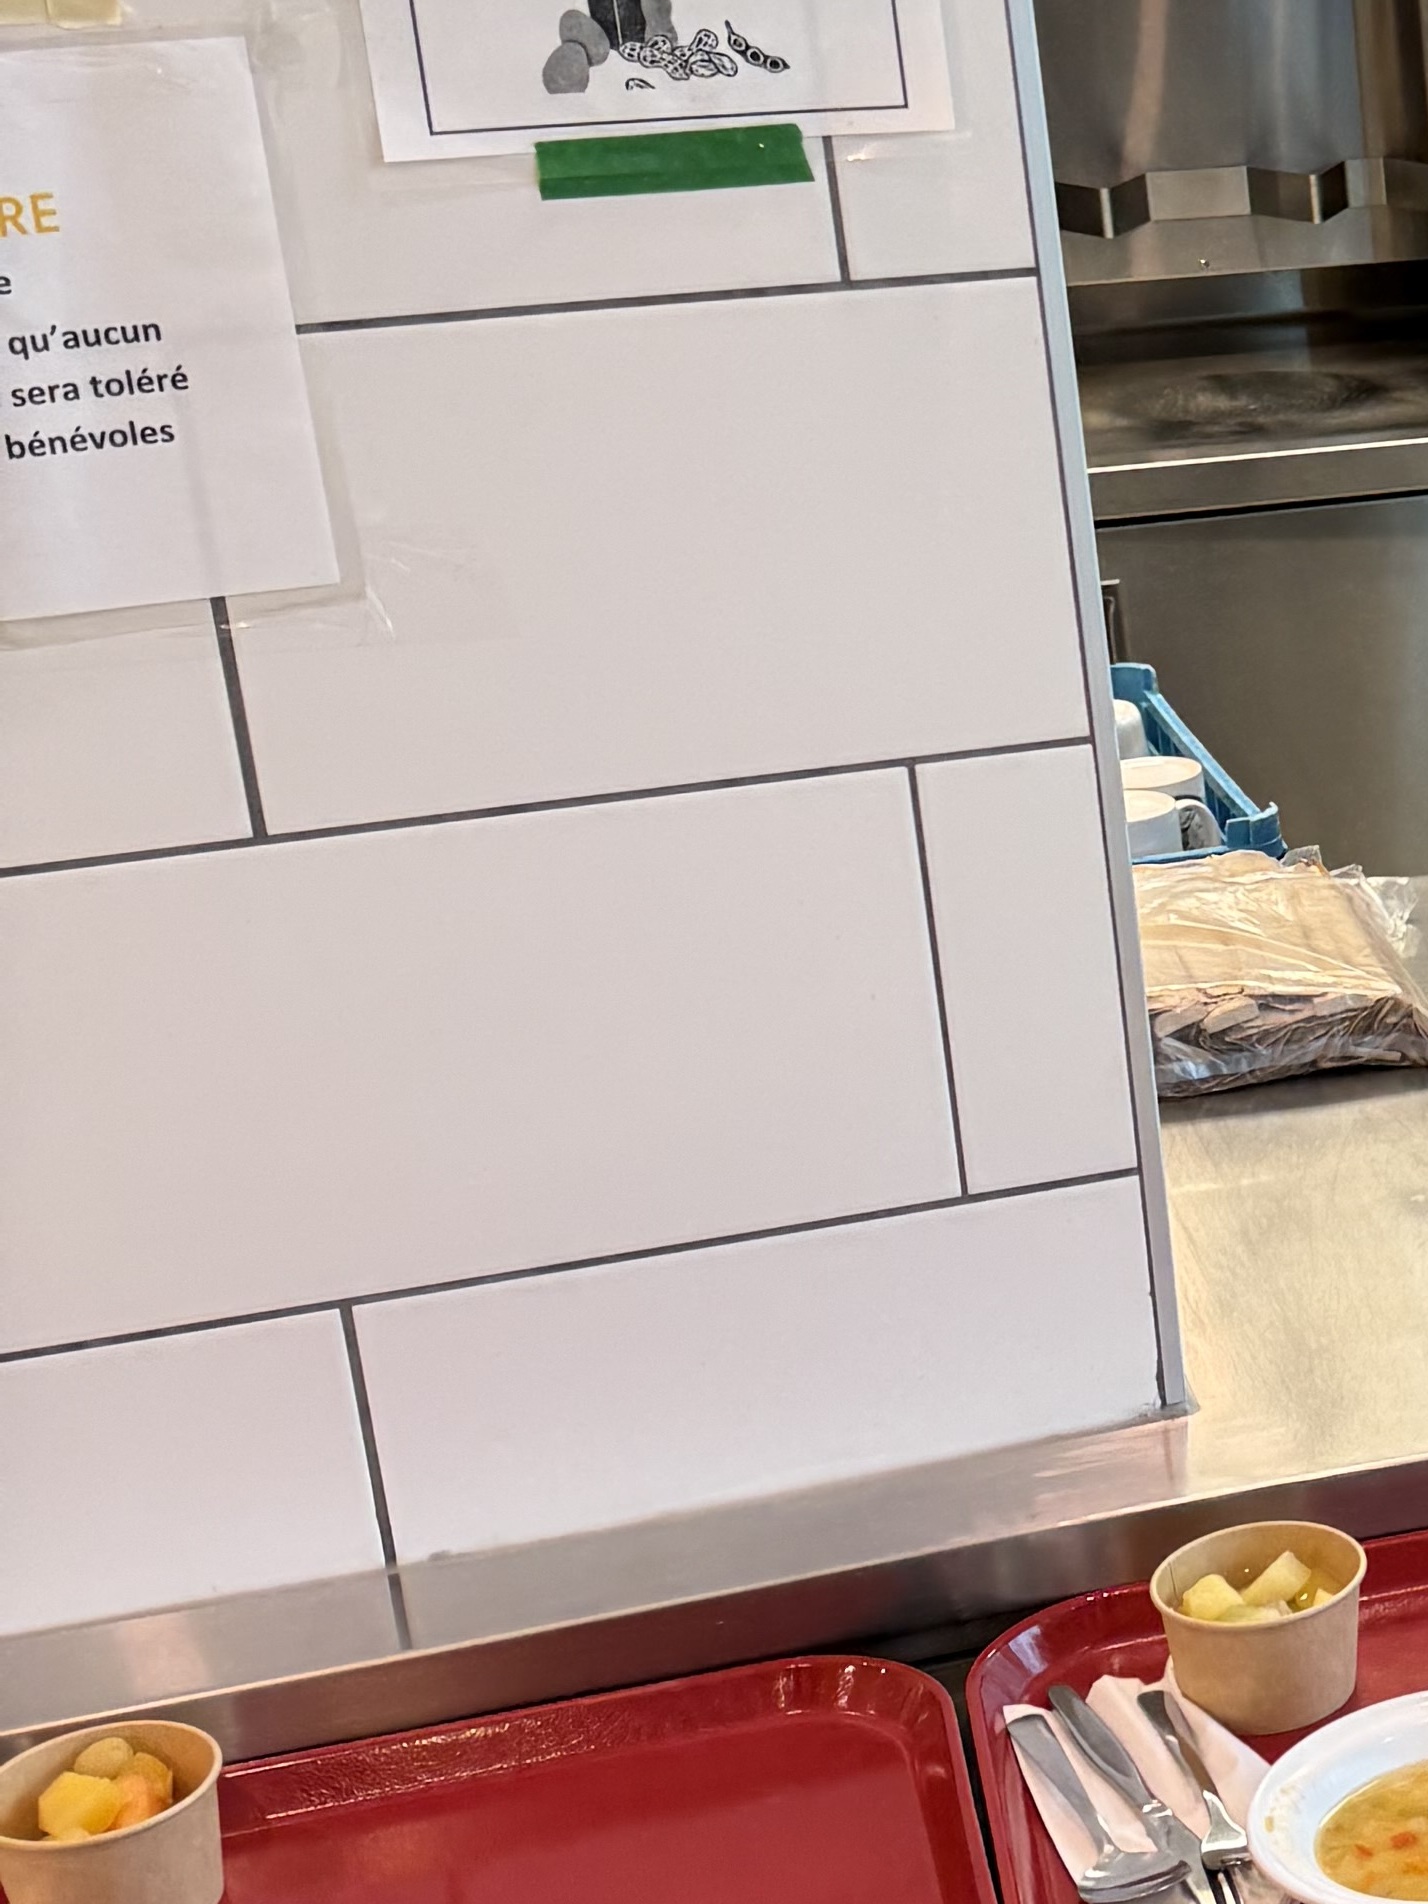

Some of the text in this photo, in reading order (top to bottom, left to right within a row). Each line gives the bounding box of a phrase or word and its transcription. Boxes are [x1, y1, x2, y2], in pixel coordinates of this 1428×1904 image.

[10, 363, 190, 408] sera toléré
[3, 419, 176, 461] bénévoles
